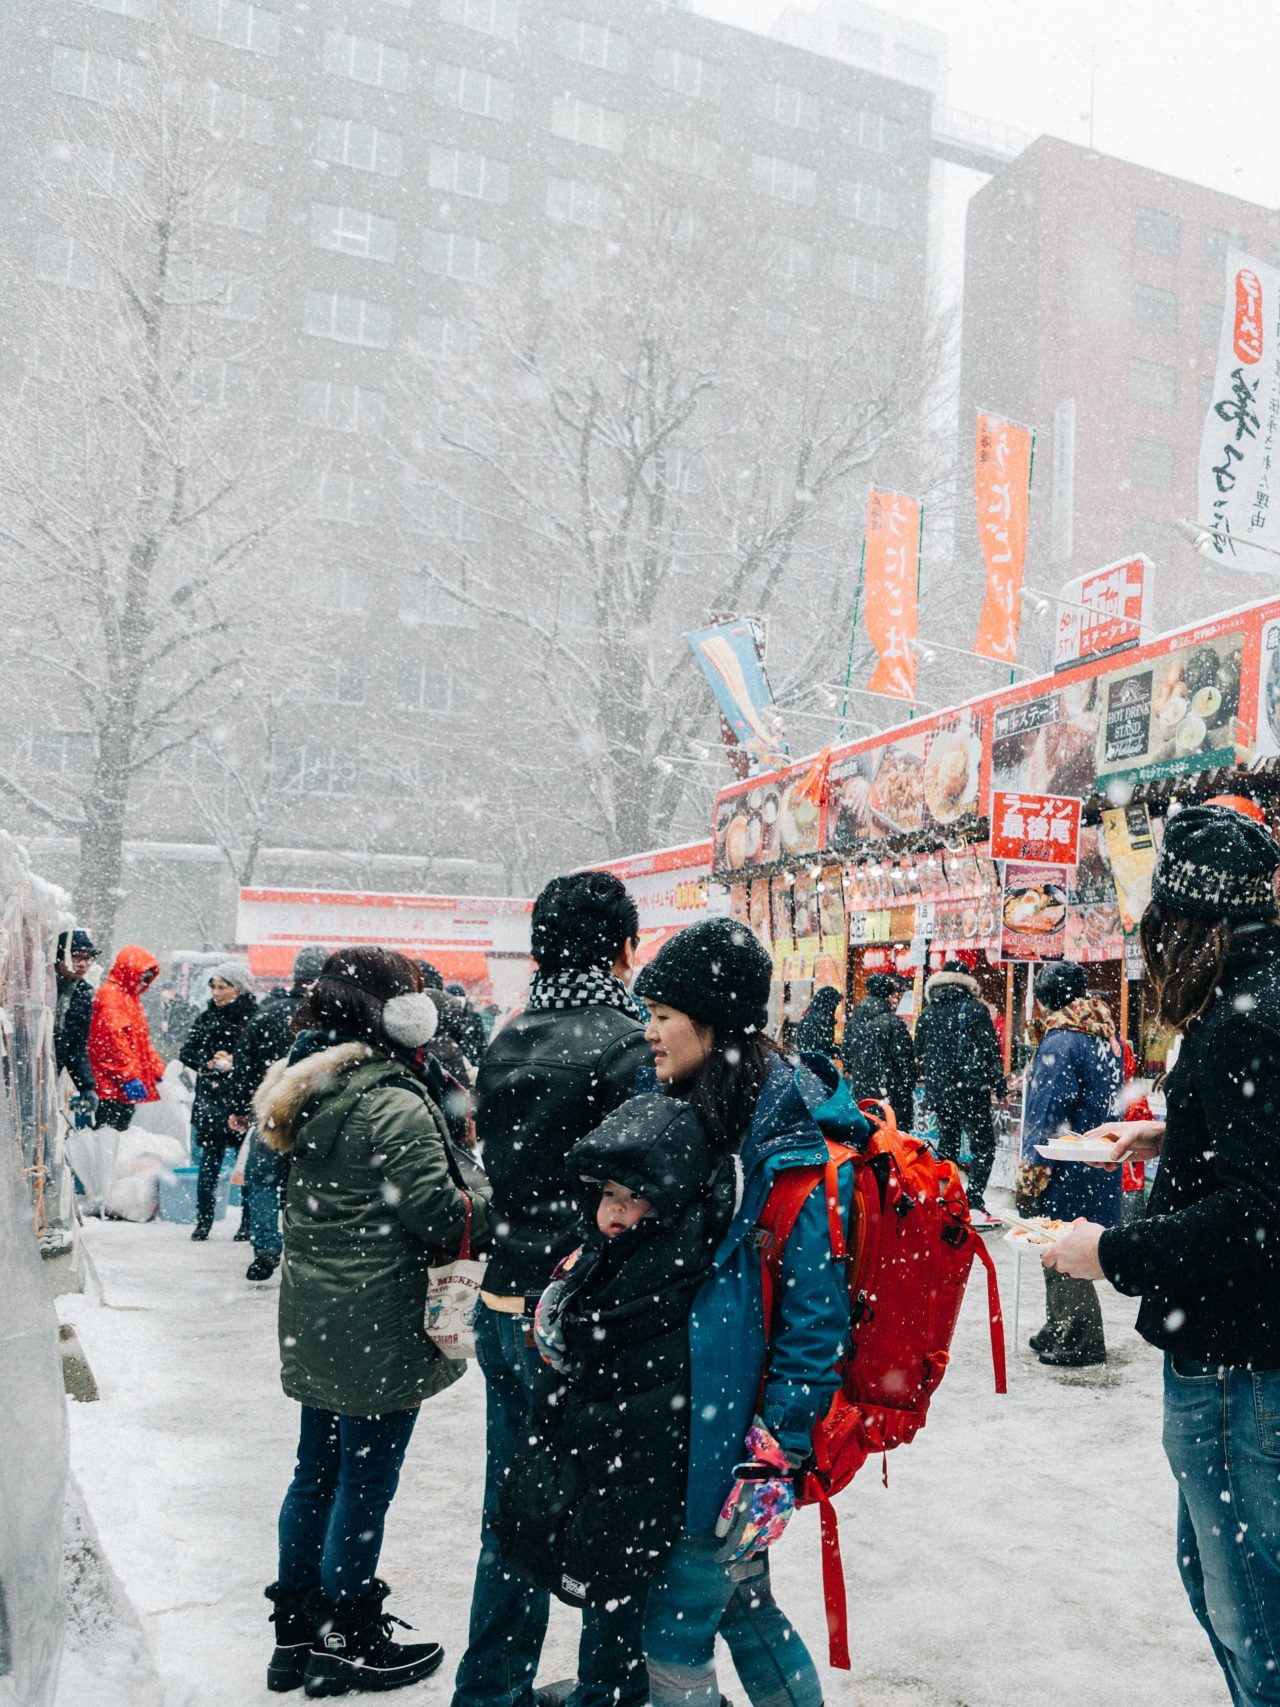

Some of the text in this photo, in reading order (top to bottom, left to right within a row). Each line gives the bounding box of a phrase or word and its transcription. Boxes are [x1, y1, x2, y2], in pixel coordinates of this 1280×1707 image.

[1114, 721, 1141, 739] STAND
[1002, 794, 1073, 819] ラーメン
[1001, 813, 1071, 845] 最後尾
[437, 1275, 482, 1291] MICKEY
